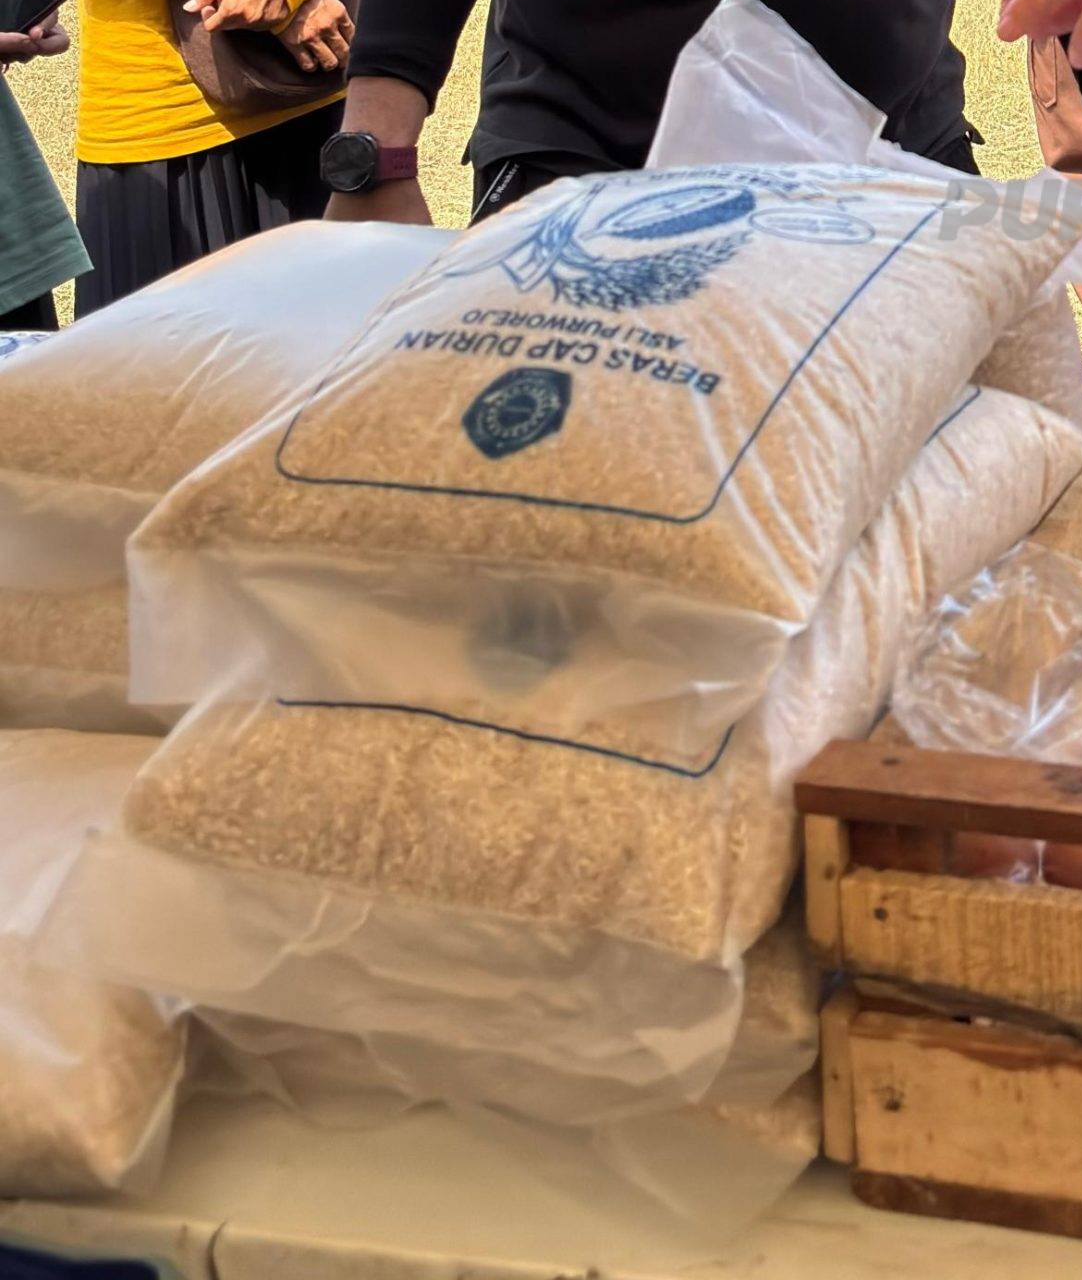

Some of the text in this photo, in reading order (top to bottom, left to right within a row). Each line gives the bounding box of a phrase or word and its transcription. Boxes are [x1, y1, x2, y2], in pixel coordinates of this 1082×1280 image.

[462, 309, 686, 350] ASLI PURWOREJO
[394, 330, 723, 396] BERAS CAP DURIAN
